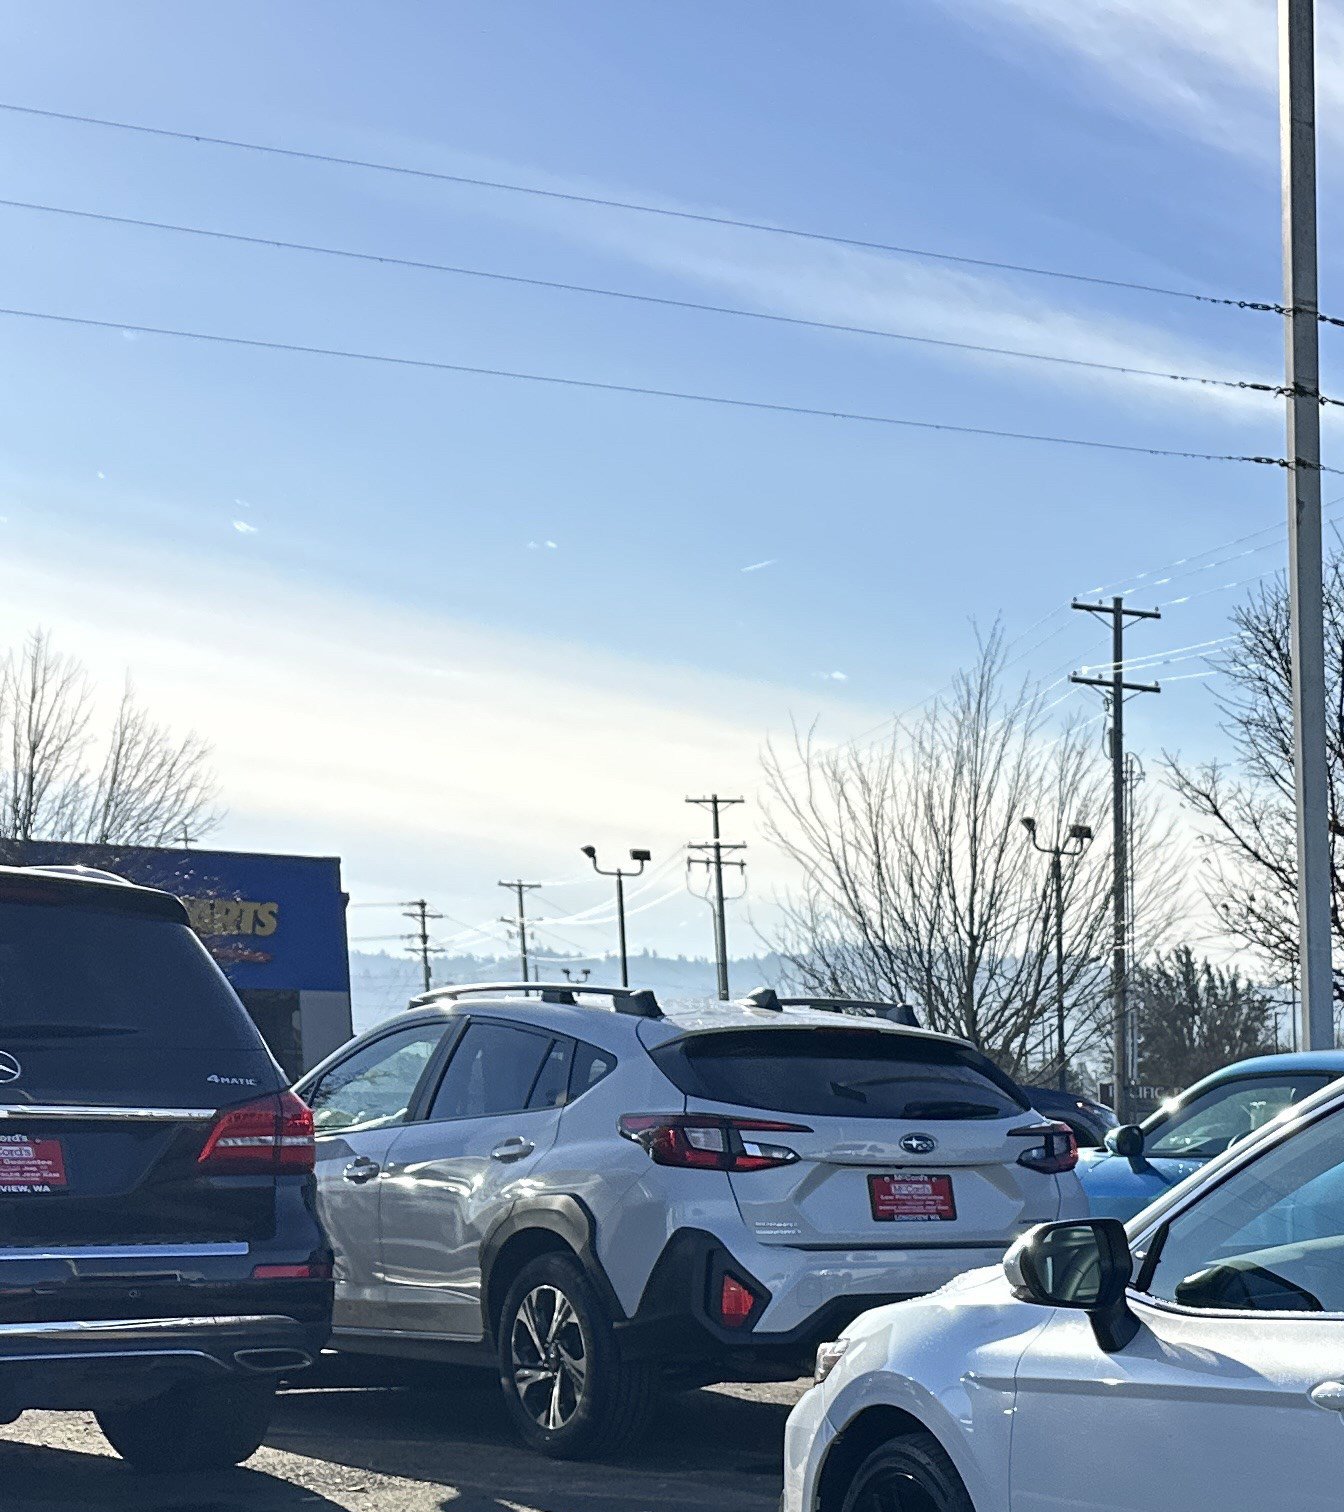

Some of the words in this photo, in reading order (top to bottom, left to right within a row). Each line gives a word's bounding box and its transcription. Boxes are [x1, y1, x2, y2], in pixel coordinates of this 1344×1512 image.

[207, 1074, 258, 1087] 4MATIC
[1108, 1084, 1166, 1100] CIFIC
[0, 1134, 28, 1142] ord's
[0, 1185, 31, 1193] VIEW,
